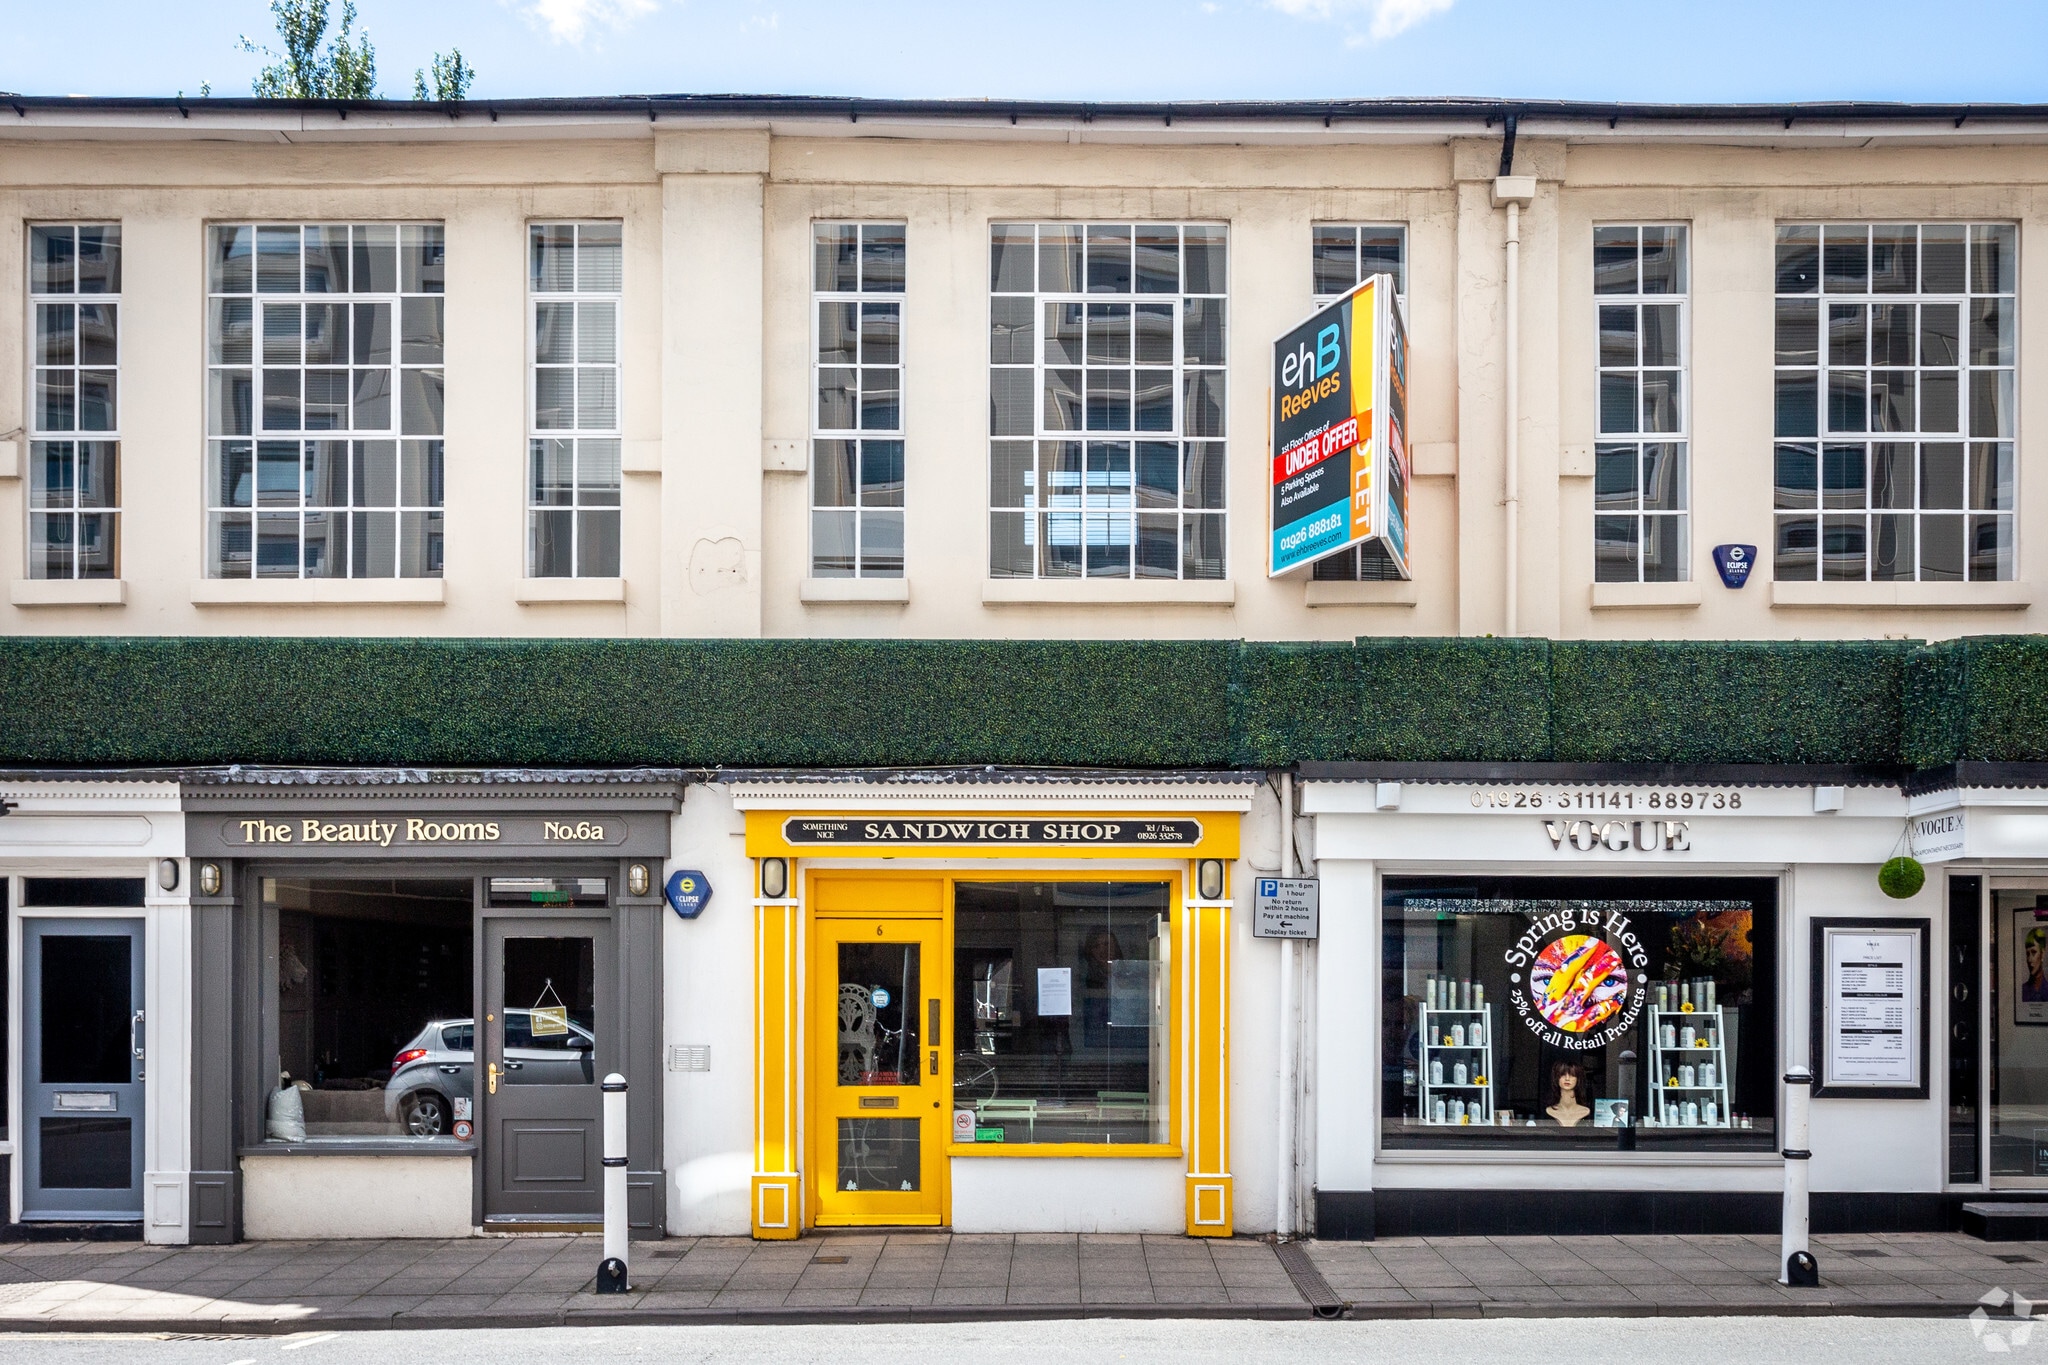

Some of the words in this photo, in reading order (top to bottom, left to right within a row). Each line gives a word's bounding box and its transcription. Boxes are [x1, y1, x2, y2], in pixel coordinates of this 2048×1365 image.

[1282, 323, 1341, 389] ehB
[1281, 371, 1341, 422] Reeves
[1281, 443, 1290, 454] 1st
[1290, 436, 1304, 450] Floor
[1304, 426, 1323, 441] Offices
[1322, 420, 1330, 431] of
[1285, 438, 1320, 476] UNDER
[1322, 418, 1358, 457] OFFER
[1280, 496, 1293, 508] Also
[1293, 482, 1320, 502] Available
[1281, 486, 1285, 496] 5
[1285, 478, 1304, 492] Parking
[1304, 467, 1325, 483] Spaces
[1355, 467, 1371, 528] LET
[1280, 527, 1307, 550] 01926
[1308, 513, 1342, 538] 888181
[1280, 530, 1342, 563] www.ehbreeves.com
[240, 819, 293, 843] The
[301, 818, 398, 847] Beauty
[406, 818, 500, 841] Rooms
[543, 821, 604, 841] No.6a
[802, 822, 848, 831] SOMETHING
[816, 831, 835, 839] NICE
[864, 823, 1030, 840] SANDWICH
[1043, 823, 1121, 840] SHOP
[1137, 832, 1157, 840] 01926
[1145, 824, 1155, 832] Tel
[1161, 824, 1175, 832] Fax
[1541, 819, 1691, 851] VOGUE
[1920, 816, 1955, 836] VOGUE
[675, 895, 700, 903] ECLIPSE
[1264, 881, 1276, 896] P
[876, 924, 883, 937] 6
[1505, 908, 1577, 968] Spring
[1580, 902, 1600, 925] is
[1603, 910, 1648, 968] Here
[1510, 988, 1531, 1017] 25%
[1525, 1016, 1548, 1036] off
[1542, 1030, 1562, 1047] all
[1563, 1032, 1607, 1050] Retail
[1604, 987, 1646, 1042] Products
